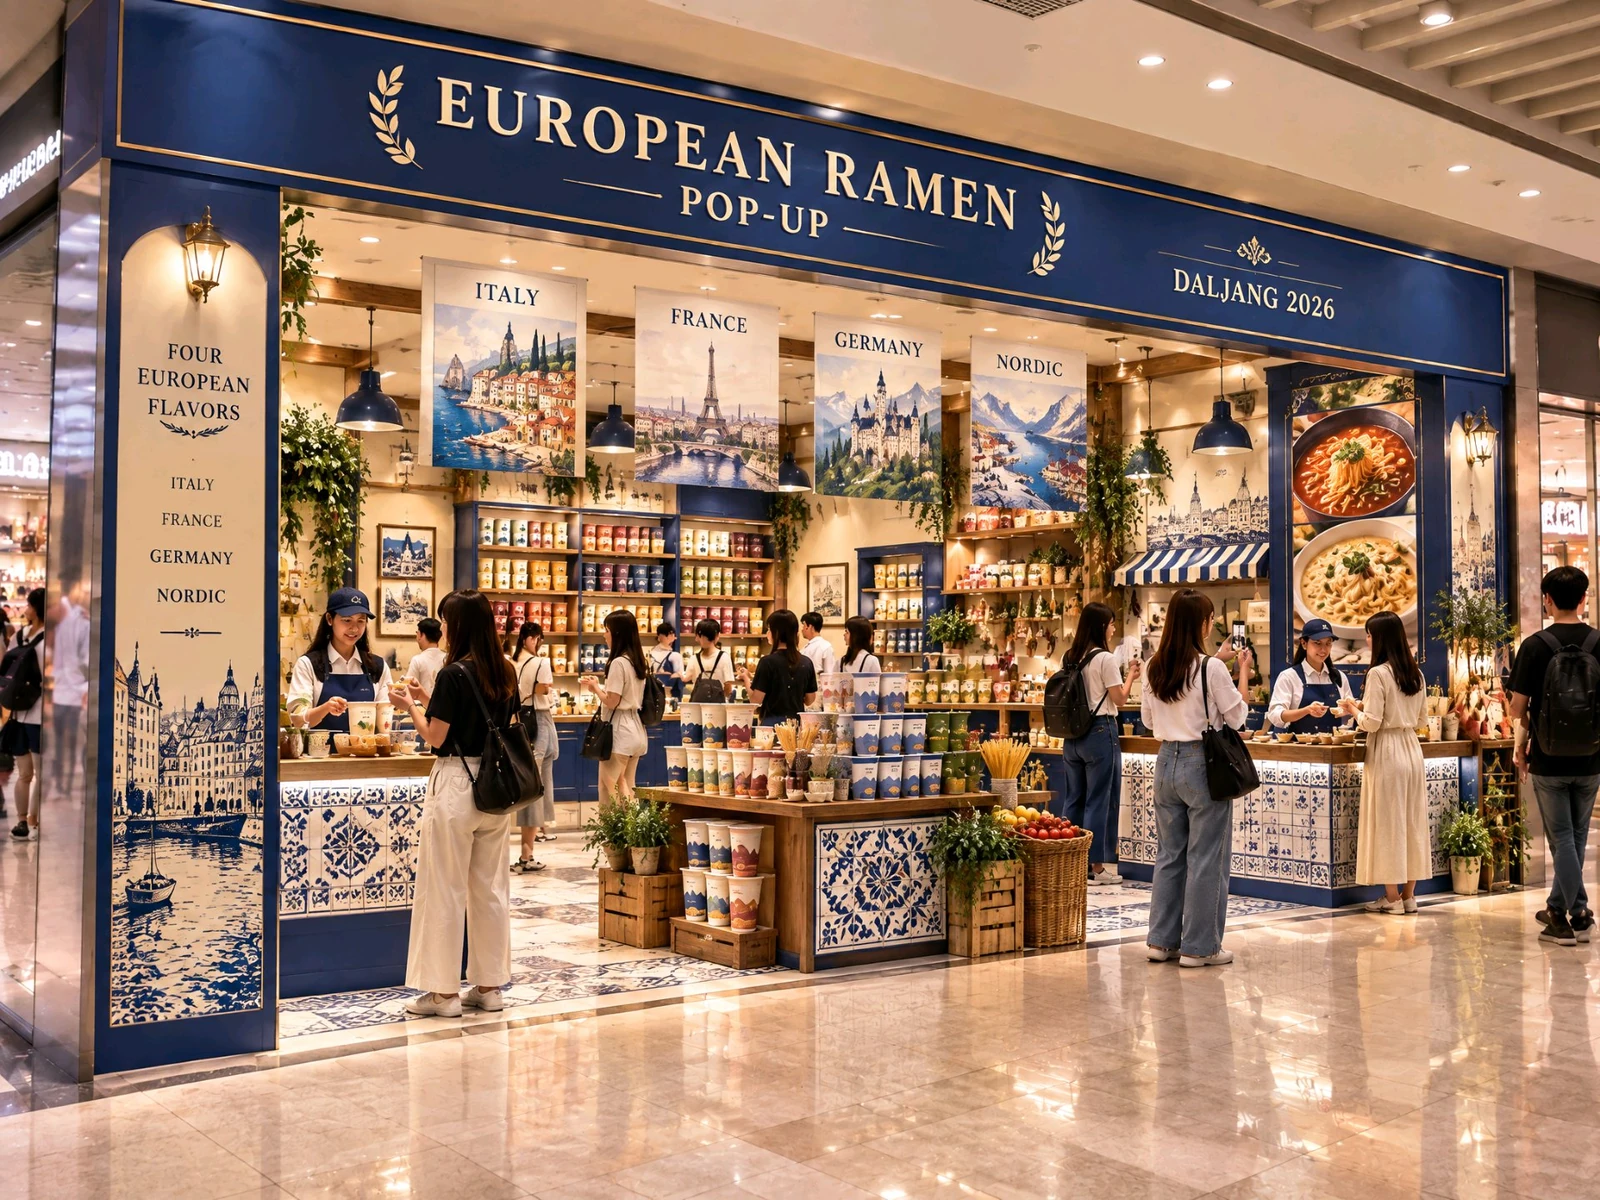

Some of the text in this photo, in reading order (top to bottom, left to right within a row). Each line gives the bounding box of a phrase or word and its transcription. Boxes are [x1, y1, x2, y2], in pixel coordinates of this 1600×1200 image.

[436, 76, 1017, 229] EUROPEAN RAMEN
[680, 186, 828, 237] POP-UP
[476, 281, 539, 306] ITALY
[1173, 268, 1334, 319] DALJANG 2026
[671, 307, 747, 333] FRANCE
[168, 342, 222, 364] FOUR
[835, 331, 923, 357] GERMANY
[997, 353, 1062, 376] NORDIC
[137, 367, 249, 393] EUROPEAN
[148, 397, 239, 420] FLAVORS
[171, 476, 213, 491] ITALY
[162, 512, 221, 526] FRANCE
[150, 548, 232, 564] GERMANY
[157, 588, 225, 603] NORDIC
